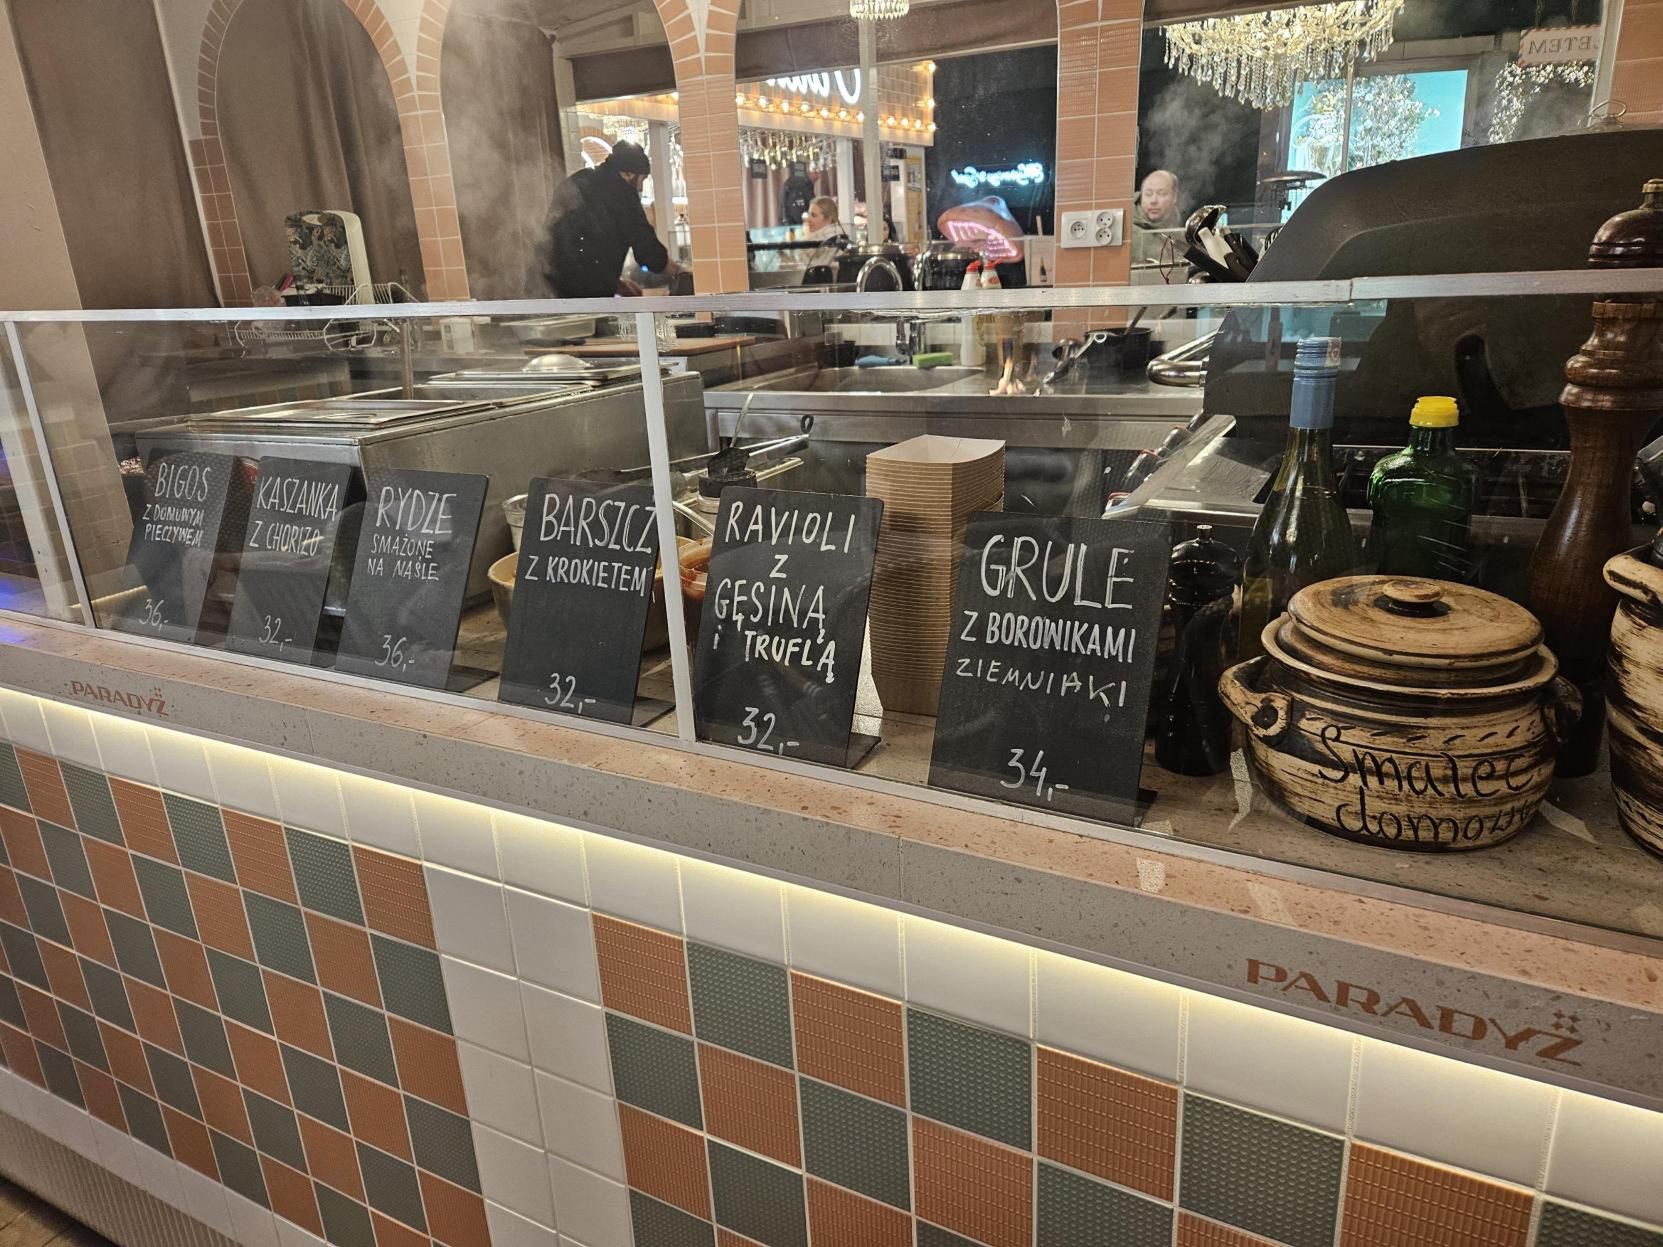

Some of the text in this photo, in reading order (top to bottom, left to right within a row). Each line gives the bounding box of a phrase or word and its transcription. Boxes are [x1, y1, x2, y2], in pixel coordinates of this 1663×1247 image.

[154, 462, 212, 502] BIGOS
[256, 476, 339, 522] KASZANKA
[142, 503, 153, 521] Z
[376, 486, 457, 535] RYDZE
[540, 493, 656, 554] BARSZCZ
[725, 500, 855, 553] RAVIOLI
[144, 523, 204, 548] PIECZYWEM
[249, 520, 320, 557] Z CHORIZO
[367, 557, 384, 577] NA
[524, 555, 647, 597] Z KROKIETEM
[769, 553, 787, 579] Z
[980, 534, 1135, 610] GRULE
[714, 578, 826, 644] GĘSINĄ
[744, 630, 836, 684] TRUFLĄ
[960, 609, 1136, 663] Z BOROWIKAMI
[70, 680, 169, 717] PARADYŻ
[544, 672, 596, 714] 32,-
[955, 658, 1127, 708] ZIEMNIAKI
[736, 706, 800, 757] 32,-
[1000, 748, 1069, 802] 34,-
[1317, 723, 1534, 799] Smalec
[1245, 957, 1584, 1067] PARADYŻ
